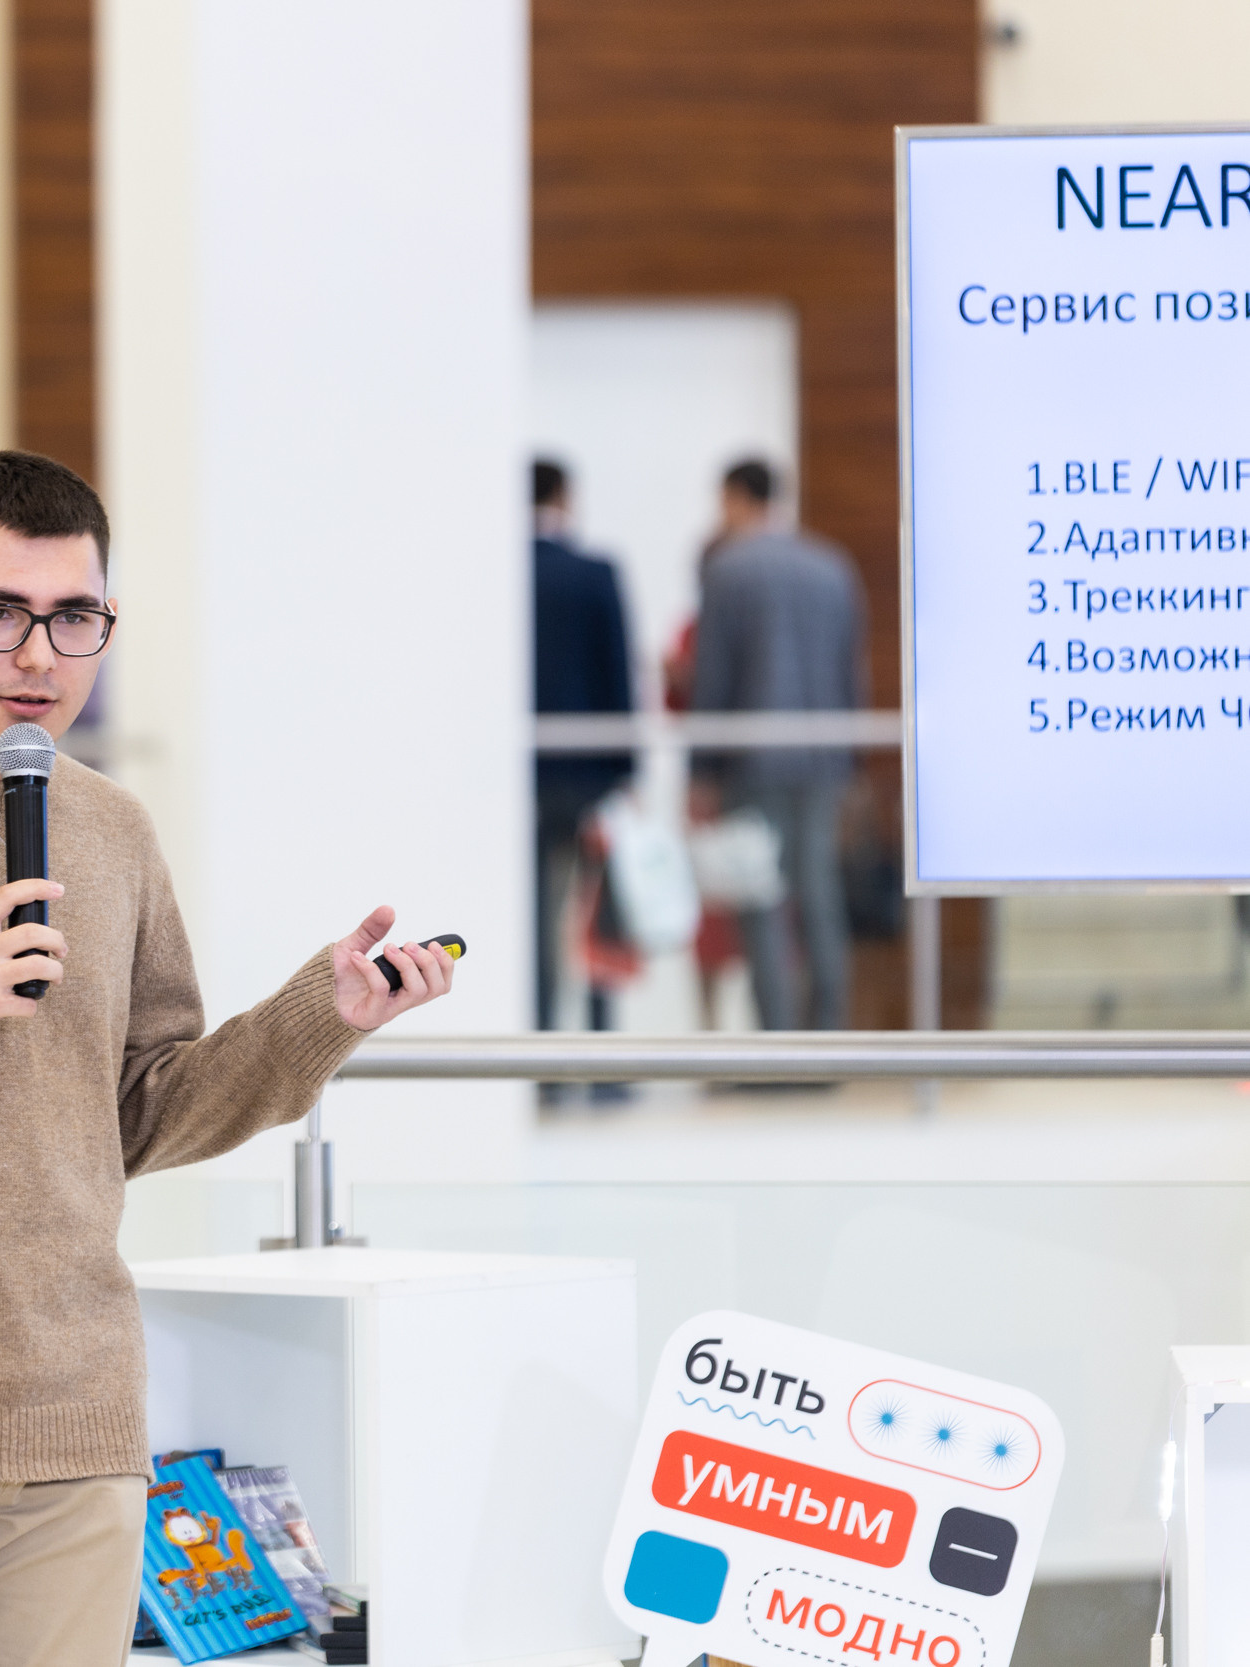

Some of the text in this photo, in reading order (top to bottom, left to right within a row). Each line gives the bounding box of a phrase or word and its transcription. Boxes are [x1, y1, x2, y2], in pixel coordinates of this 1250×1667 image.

[1055, 162, 1250, 232] NEAR
[957, 283, 1250, 336] Сервис поз
[1027, 459, 1132, 496] 1.BLE
[1027, 578, 1250, 623] 3.Треккинг
[1028, 695, 1250, 734] 5.Режим Ч
[685, 1338, 825, 1415] быть
[677, 1453, 894, 1545] умным
[765, 1588, 961, 1667] модно
